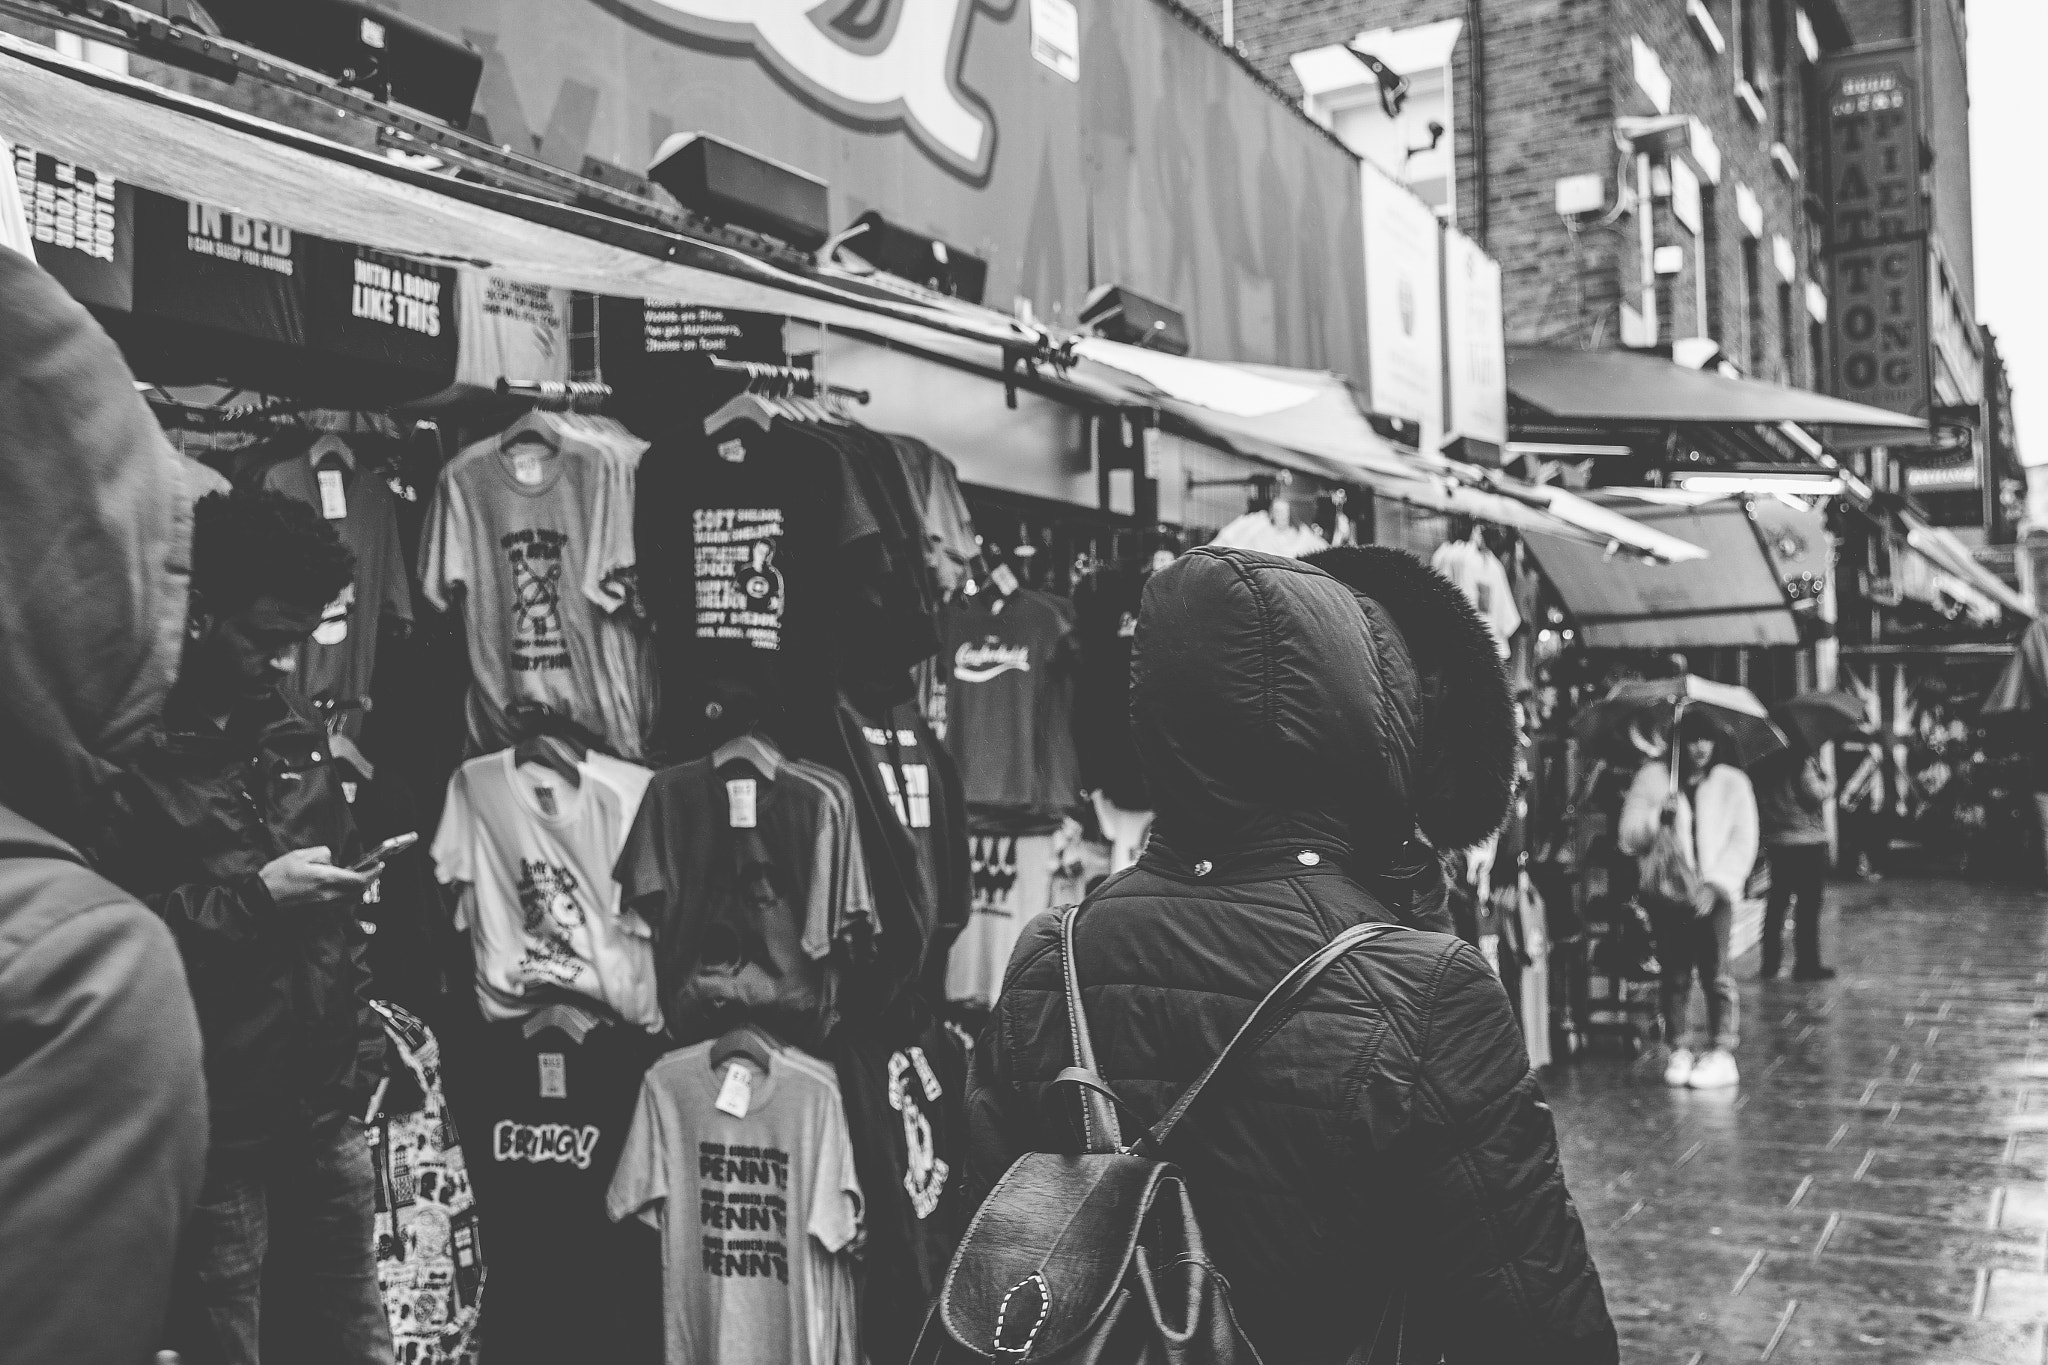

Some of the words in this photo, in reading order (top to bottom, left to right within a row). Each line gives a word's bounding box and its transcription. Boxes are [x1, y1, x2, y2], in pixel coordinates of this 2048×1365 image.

[36, 180, 55, 244] HEAD
[55, 186, 75, 249] YOUR
[75, 179, 95, 258] FUNNY
[96, 200, 115, 263] LOOK
[353, 257, 391, 291] WITH
[391, 268, 402, 294] A
[402, 271, 441, 304] BODY
[1832, 114, 1881, 389] TATTOO
[352, 283, 394, 325] LIKE
[395, 294, 441, 337] THIS
